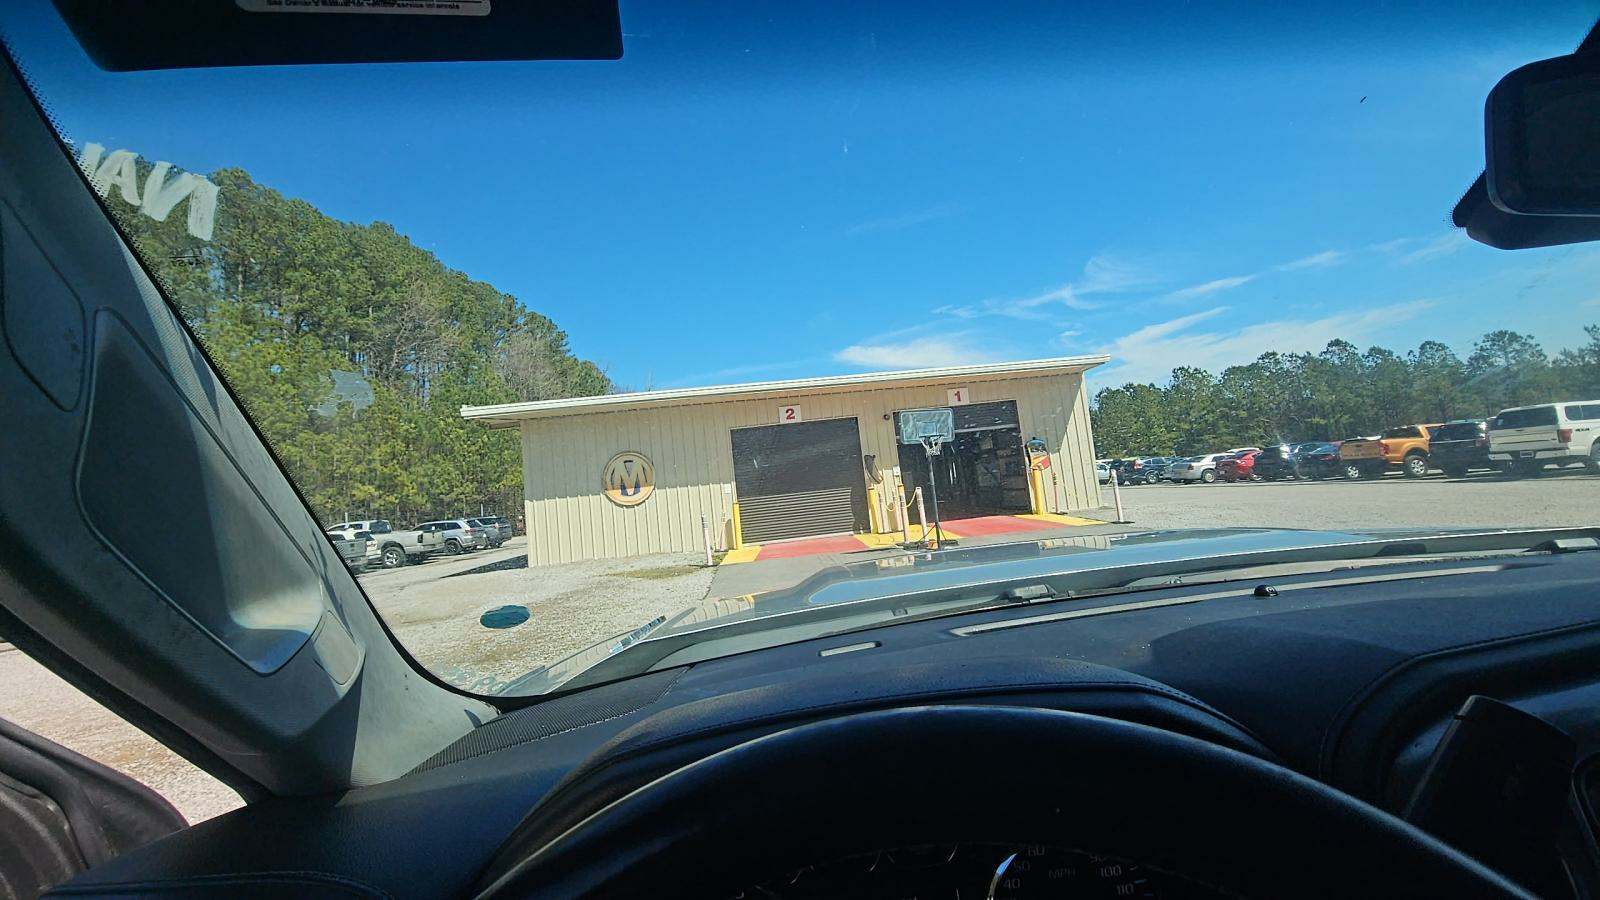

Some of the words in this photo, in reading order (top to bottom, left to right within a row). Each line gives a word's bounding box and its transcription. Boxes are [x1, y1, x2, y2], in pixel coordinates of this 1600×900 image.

[954, 391, 962, 402] 1
[785, 408, 796, 420] 2
[610, 461, 648, 497] M
[1100, 865, 1122, 877] 100
[1003, 877, 1021, 890] 40
